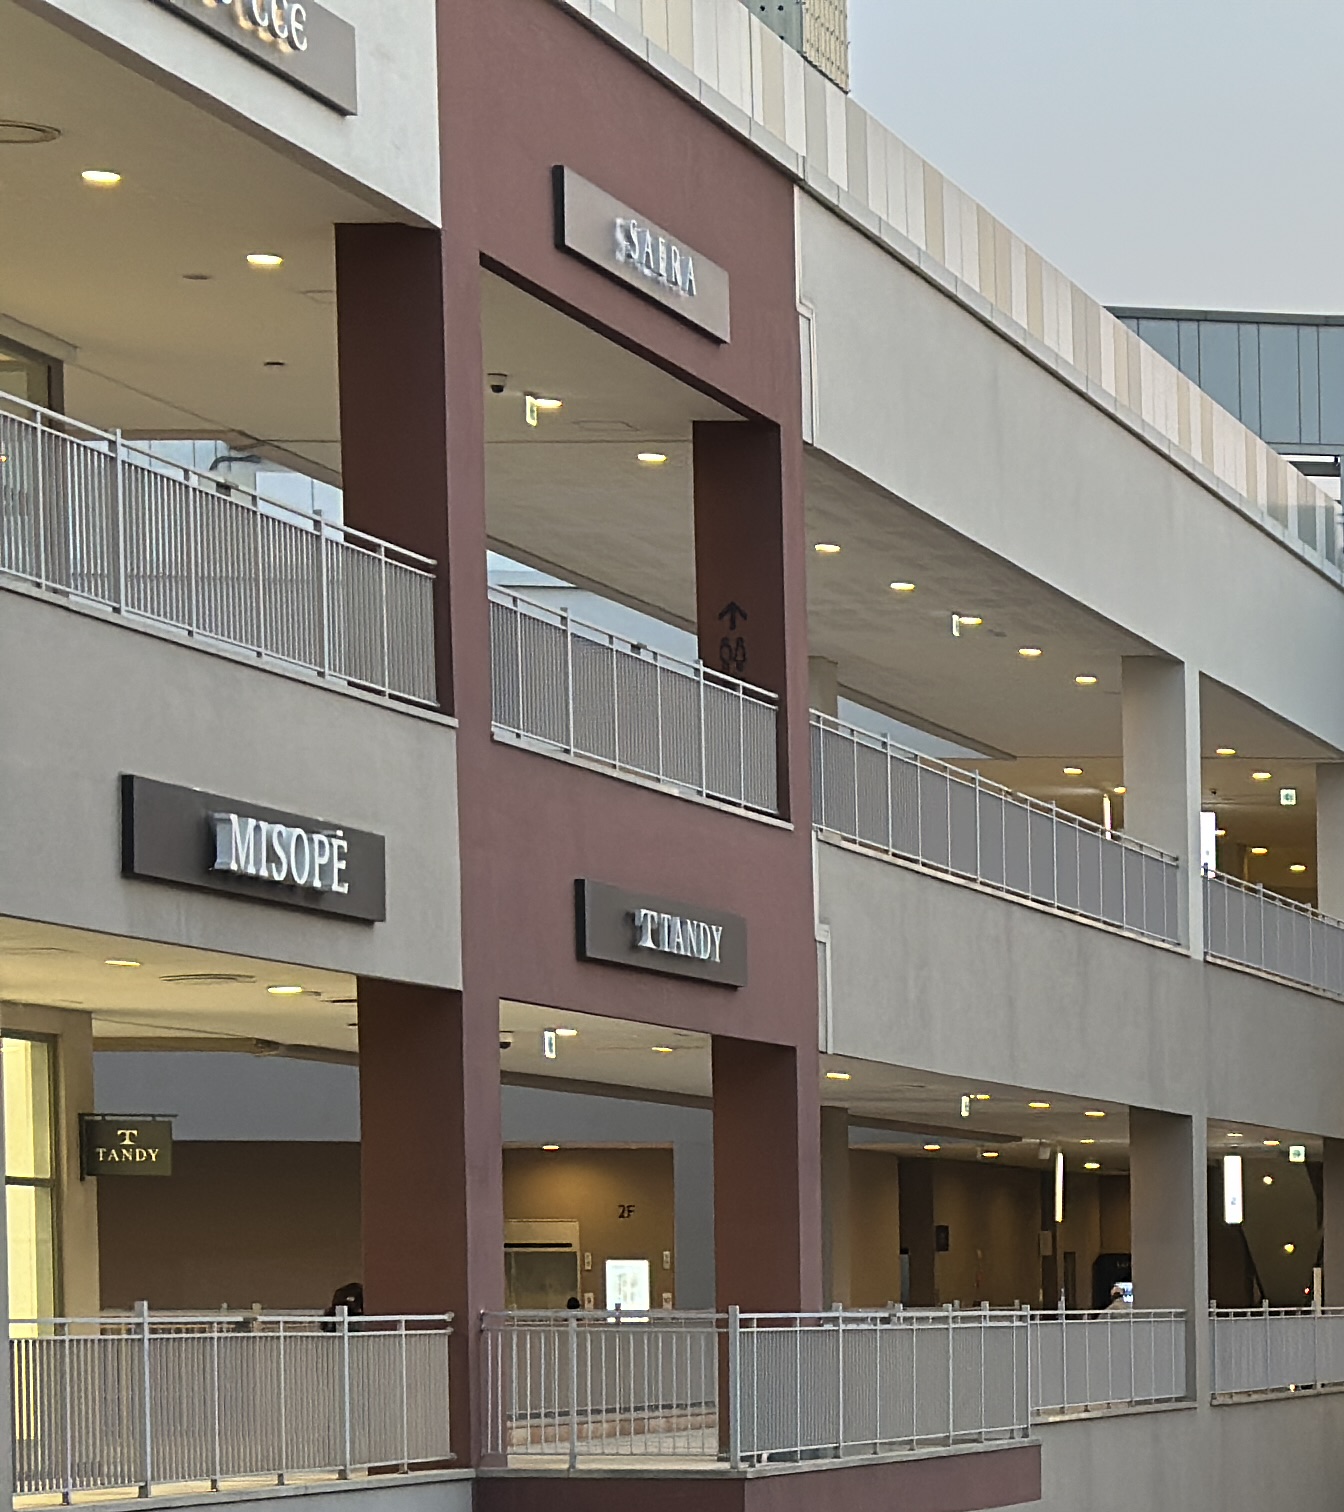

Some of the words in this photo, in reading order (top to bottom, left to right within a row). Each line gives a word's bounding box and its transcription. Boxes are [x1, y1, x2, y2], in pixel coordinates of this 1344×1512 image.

[628, 218, 697, 297] SAERA
[660, 912, 723, 963] TANDY
[95, 1147, 159, 1162] TANDY
[618, 1204, 636, 1219] 2F
